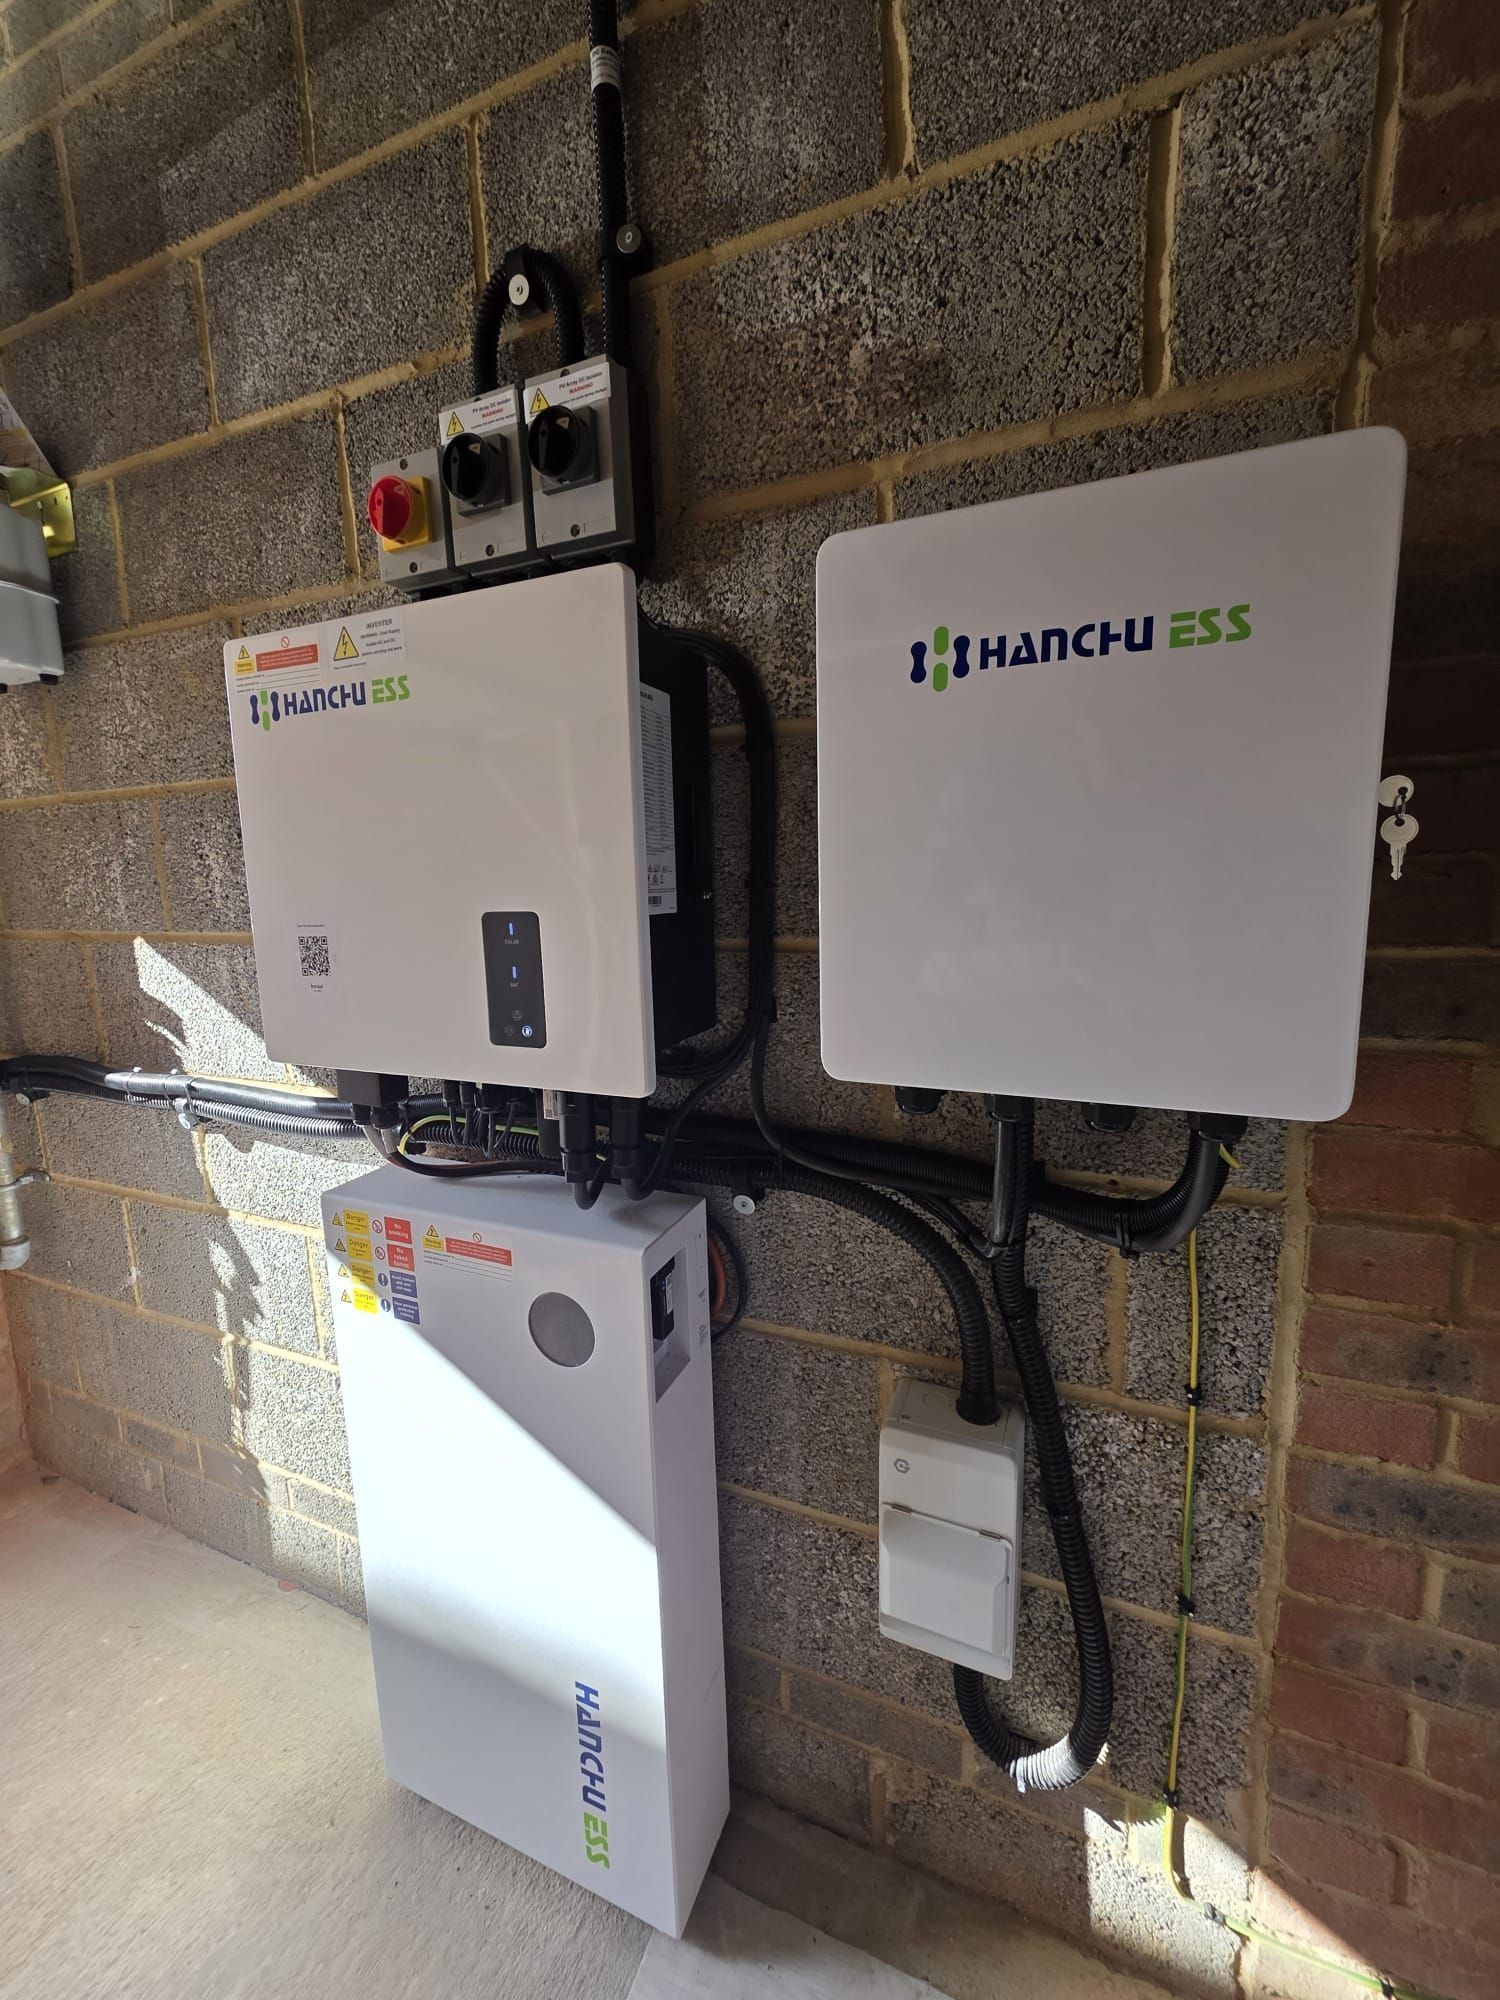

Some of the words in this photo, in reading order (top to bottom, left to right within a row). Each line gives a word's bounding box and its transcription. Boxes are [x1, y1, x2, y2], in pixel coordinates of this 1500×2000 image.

[569, 383, 594, 394] WARNING
[481, 407, 504, 418] WARNING
[366, 618, 393, 629] INVERTER
[980, 615, 1154, 670] HANCHU
[1168, 603, 1252, 649] ESS
[283, 681, 367, 716] HANCHU
[371, 674, 410, 704] ESS
[346, 1213, 366, 1222] Danger
[388, 1230, 409, 1239] smoking
[349, 1239, 369, 1248] Danger
[351, 1265, 372, 1275] Danger
[574, 1680, 607, 1813] HANCHU
[583, 1811, 610, 1870] ESS
